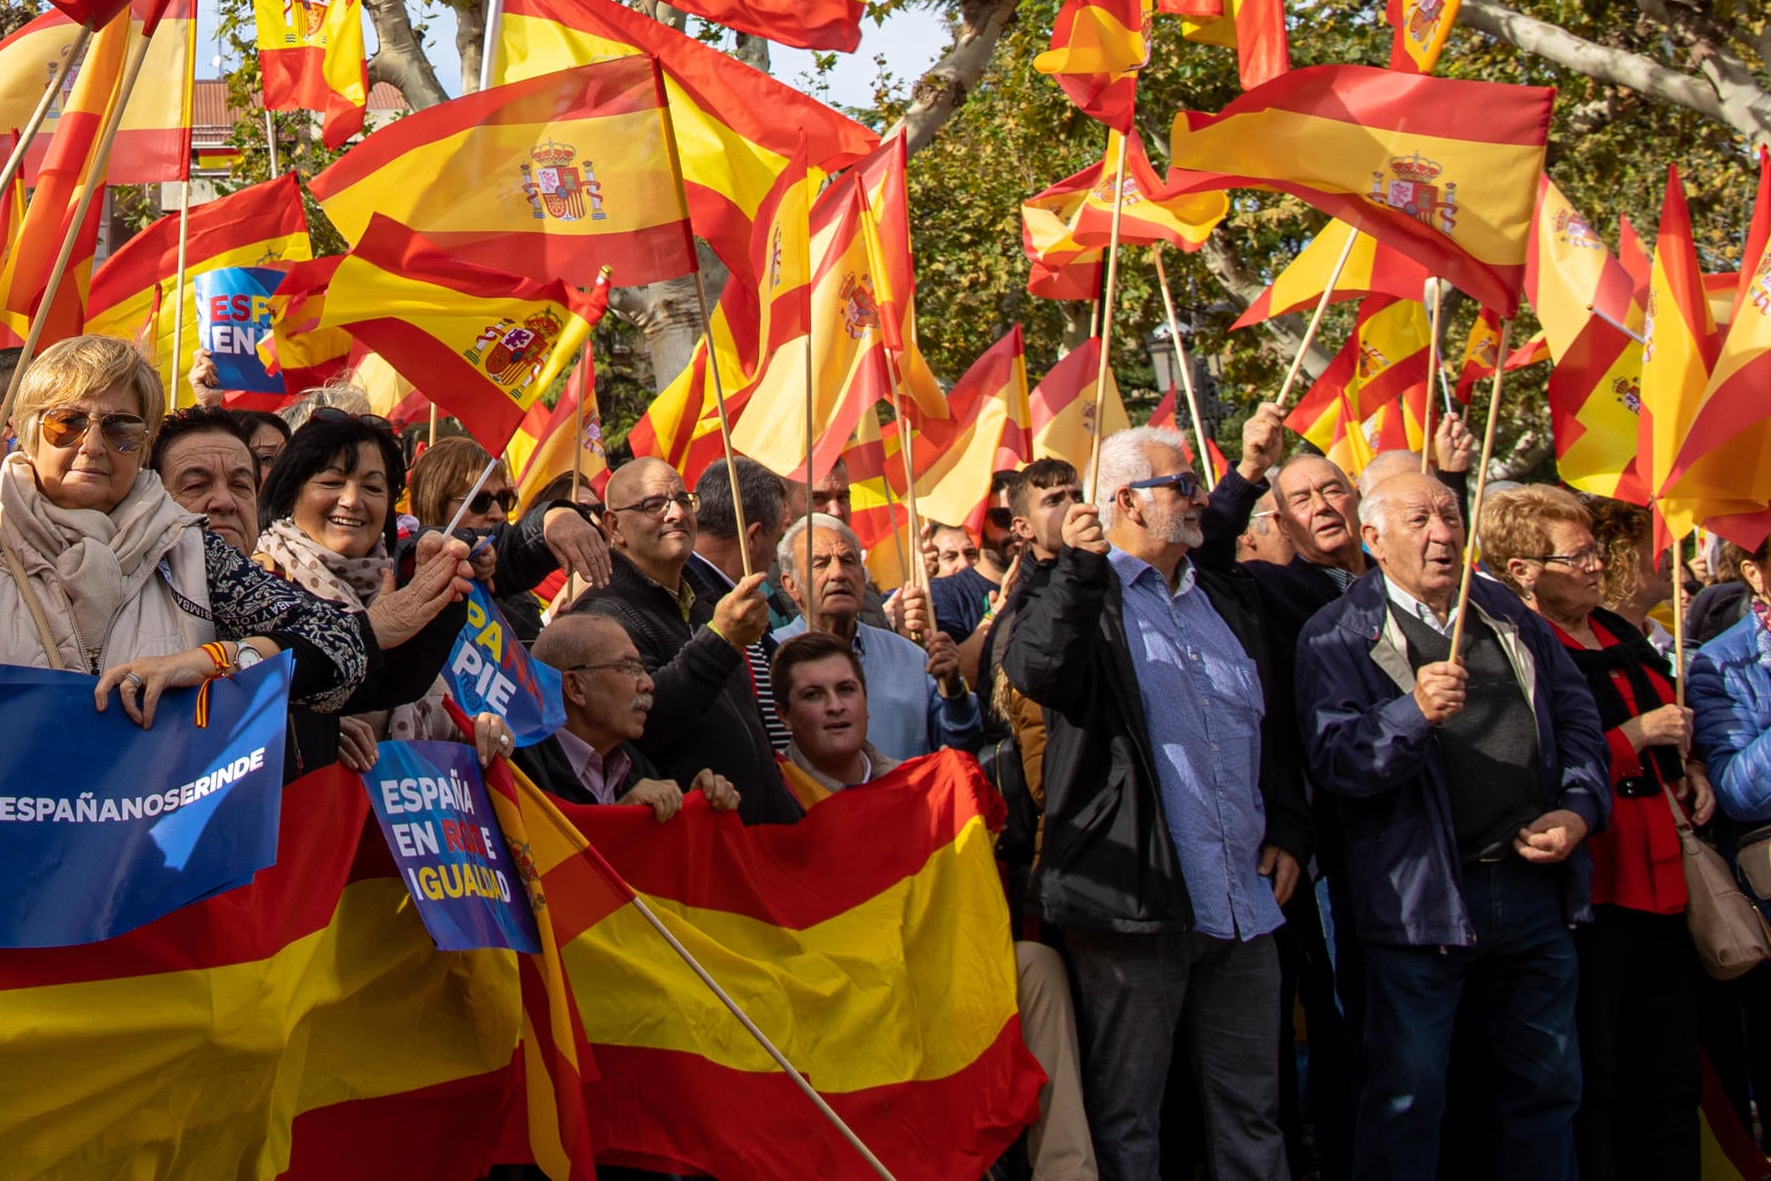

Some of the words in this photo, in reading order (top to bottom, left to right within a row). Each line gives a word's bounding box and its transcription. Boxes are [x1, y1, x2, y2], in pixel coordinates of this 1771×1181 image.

[209, 293, 273, 323] ESP
[211, 325, 255, 356] EN
[176, 594, 214, 621] BIMBA
[220, 614, 259, 626] LOLA
[261, 610, 271, 621] Y
[451, 640, 518, 717] PIE
[379, 768, 476, 816] ESPAÑA
[391, 820, 440, 858] EN
[479, 826, 497, 861] E
[406, 863, 512, 904] IGUALDAD
